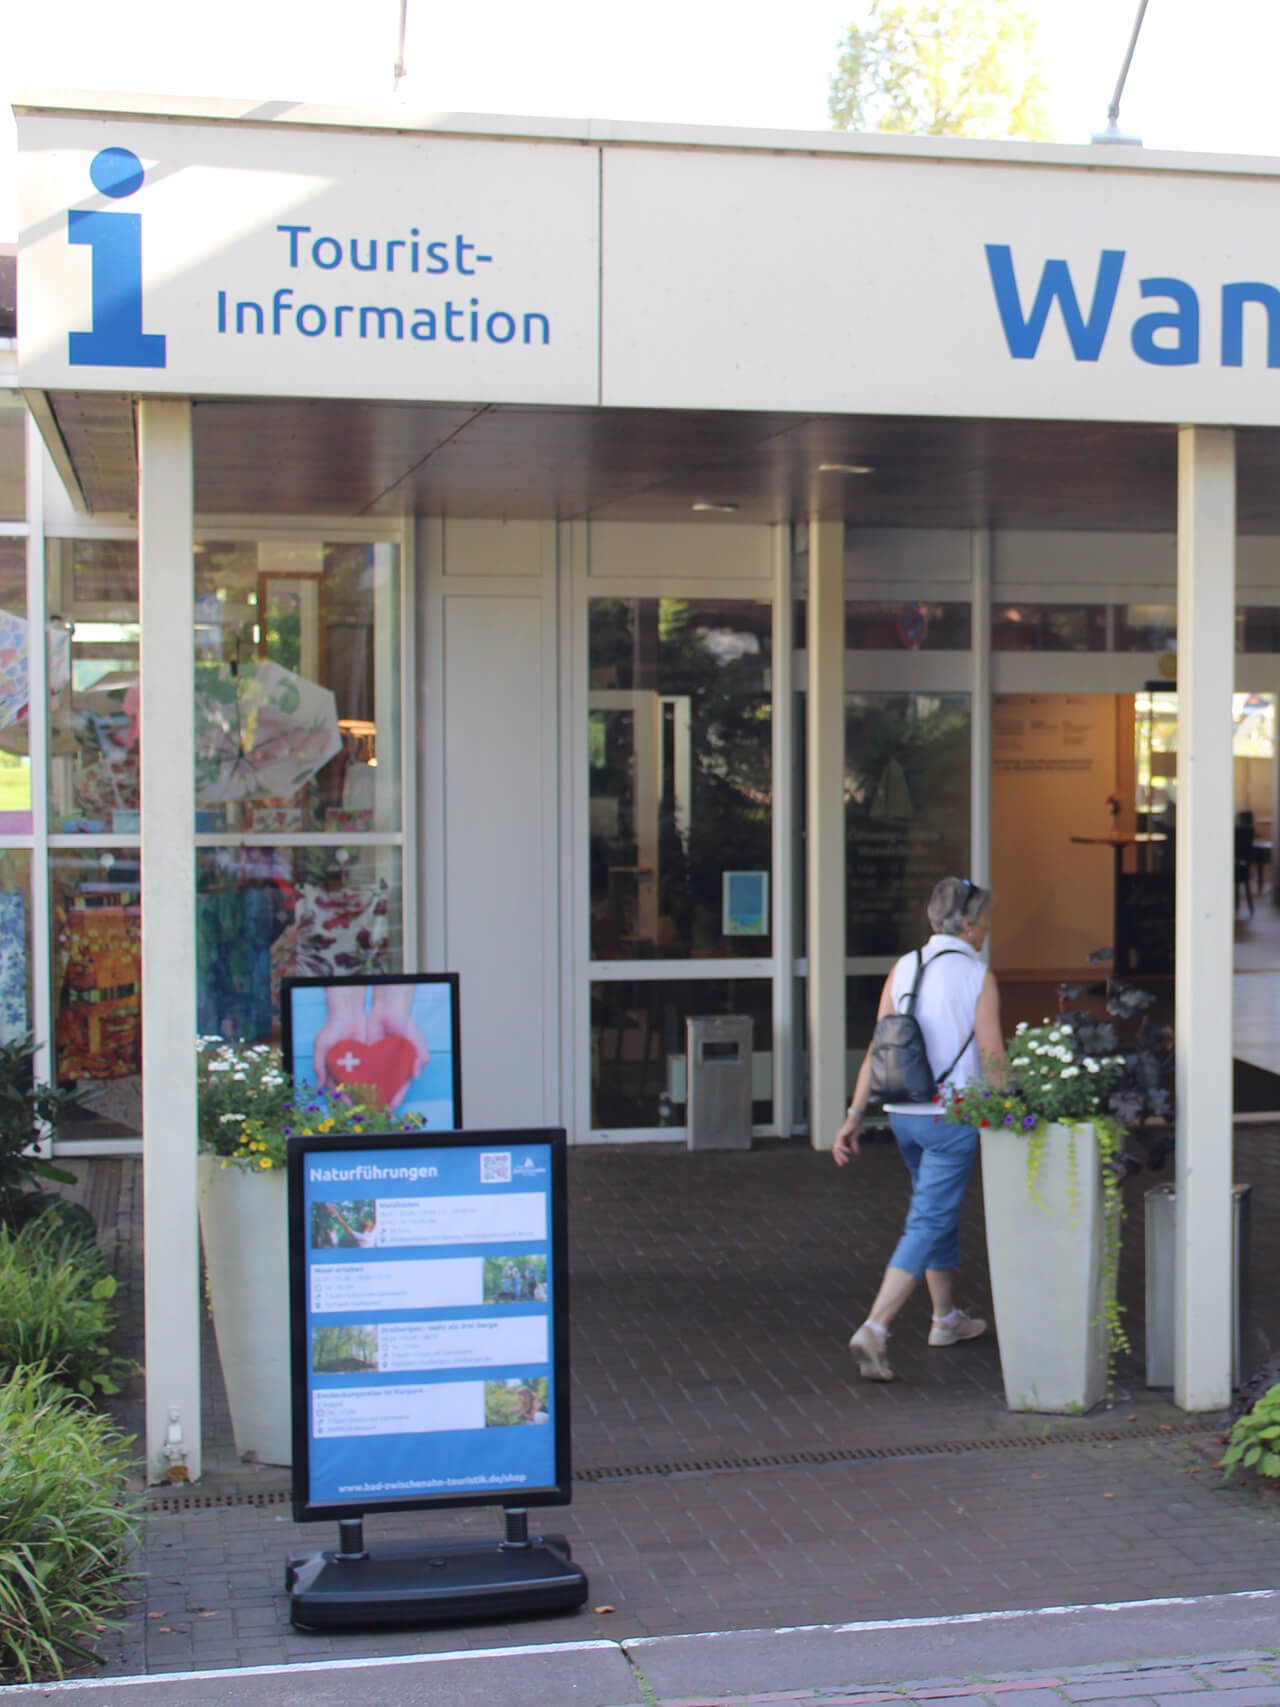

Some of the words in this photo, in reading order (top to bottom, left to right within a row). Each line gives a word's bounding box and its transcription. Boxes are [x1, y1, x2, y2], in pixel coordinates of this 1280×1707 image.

[276, 225, 493, 275] Tourist-
[217, 288, 551, 345] Information
[309, 1165, 438, 1182] Naturführungen
